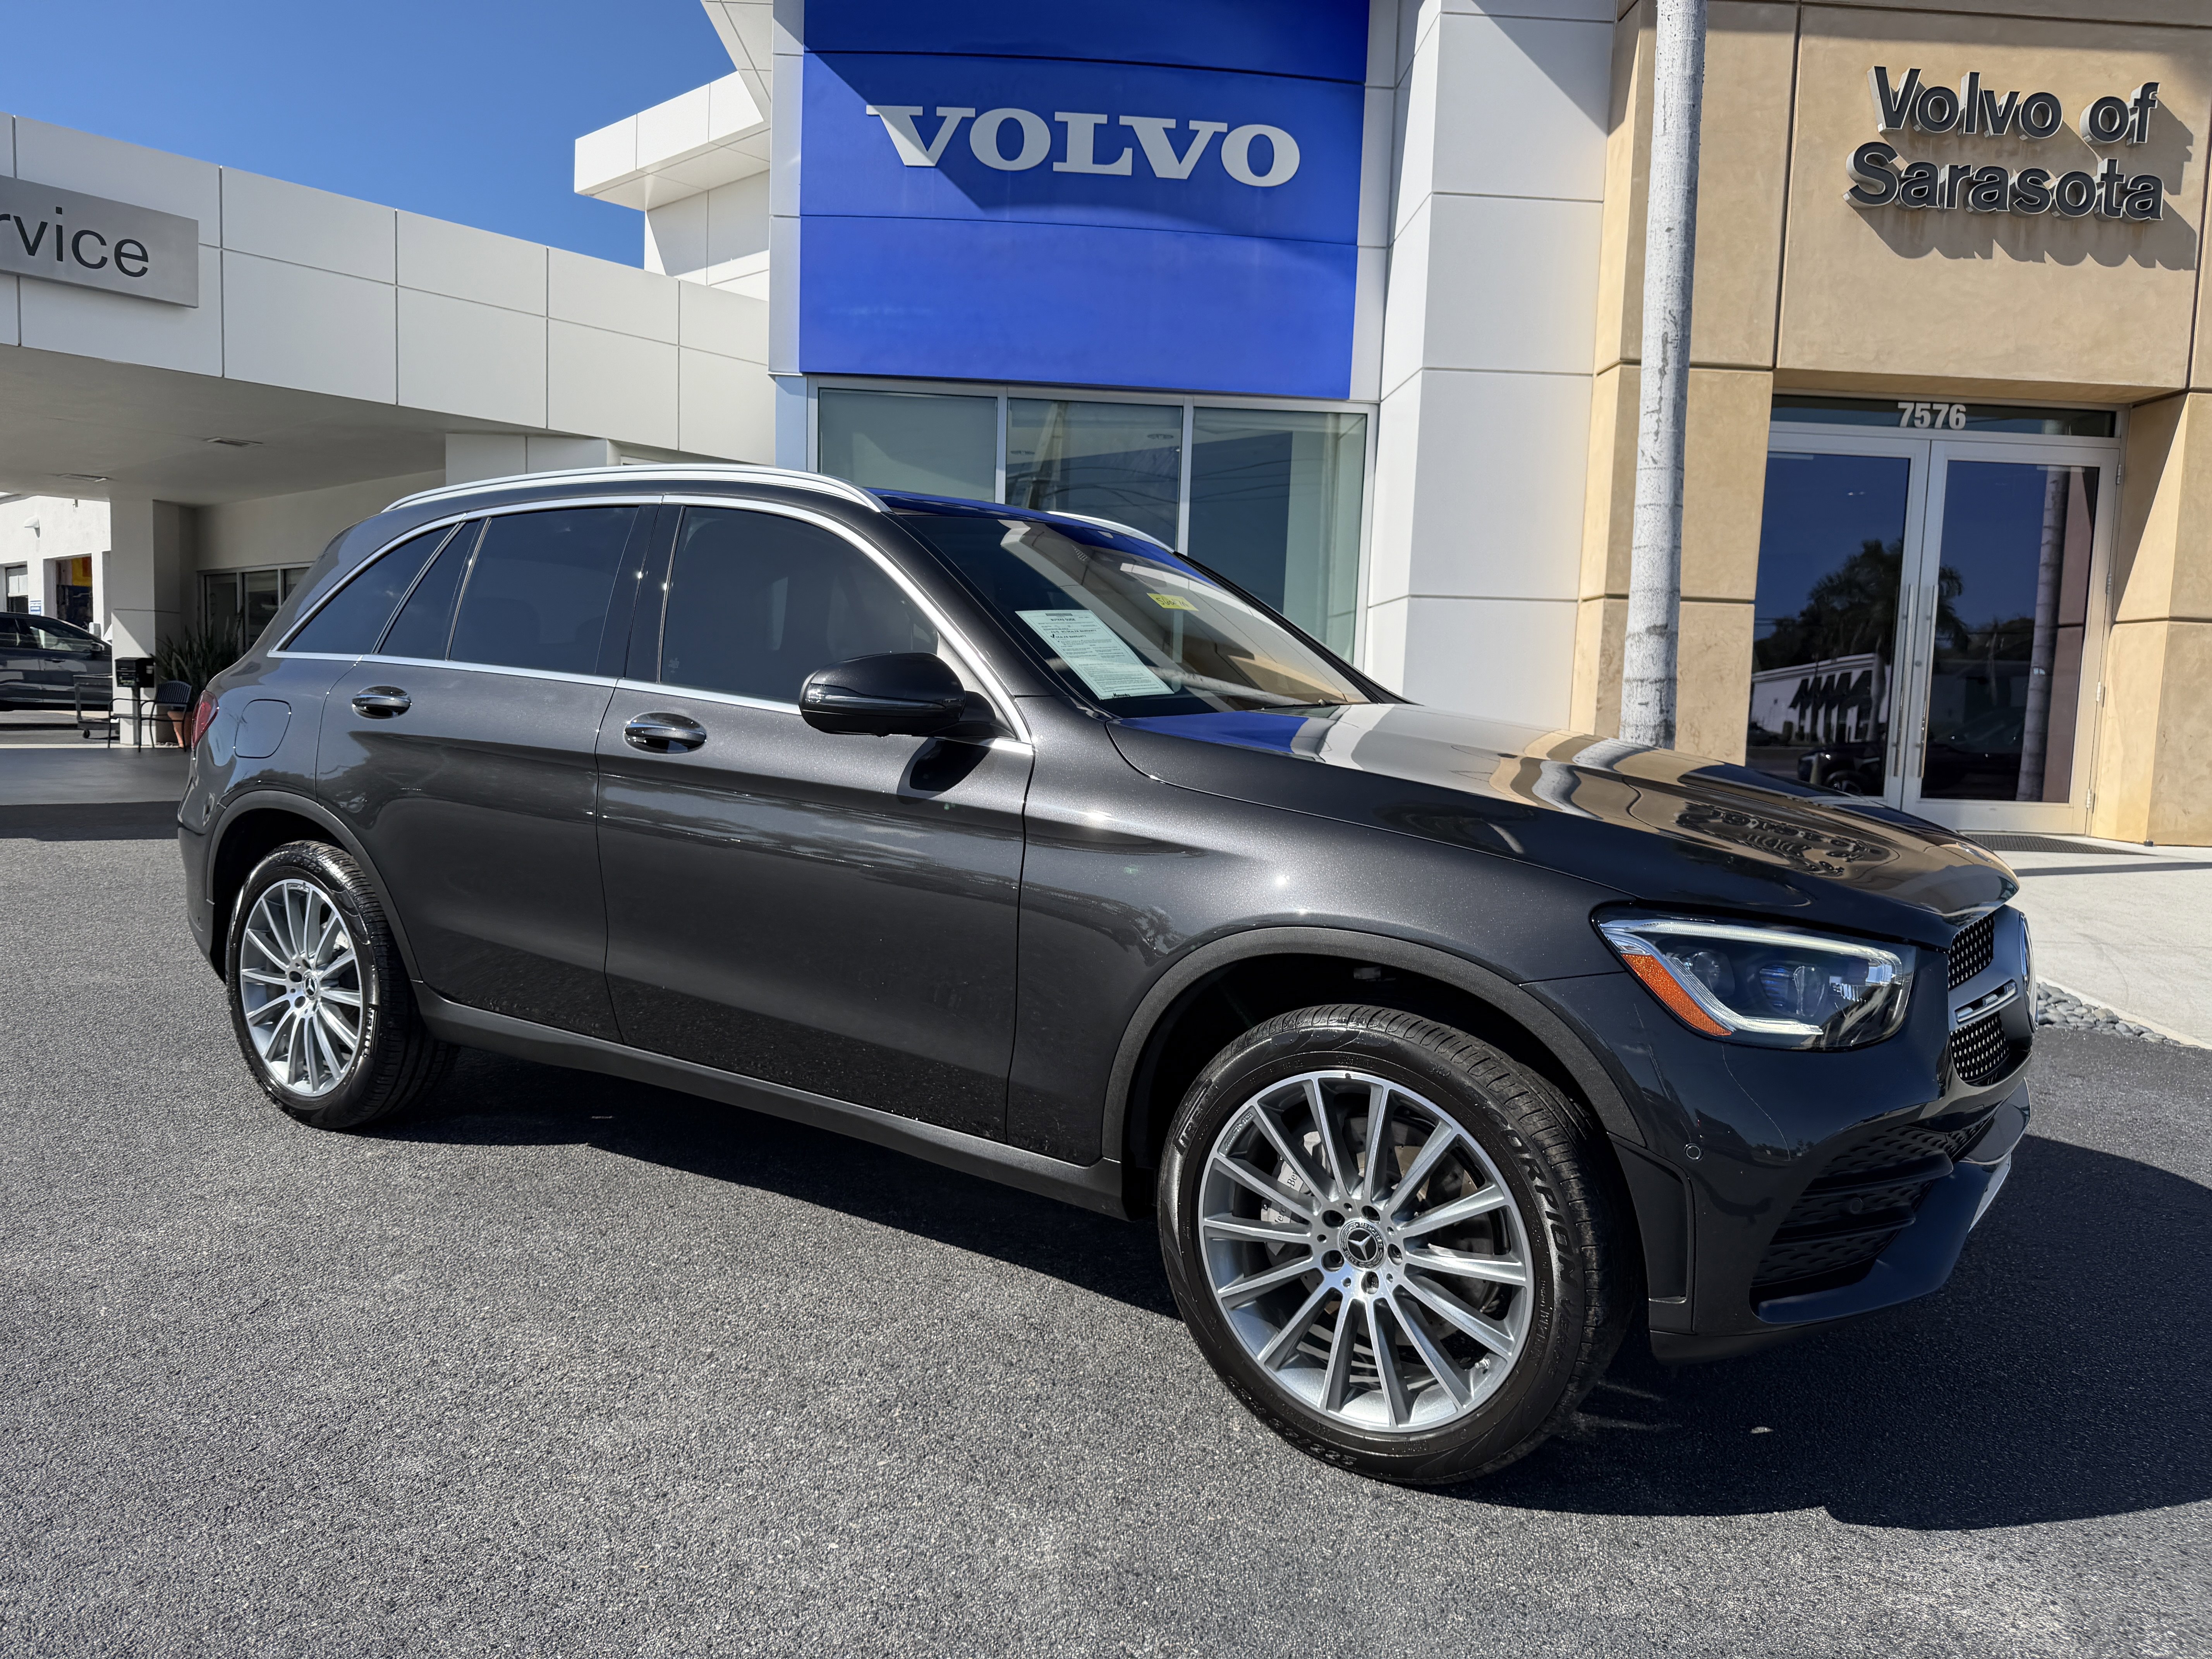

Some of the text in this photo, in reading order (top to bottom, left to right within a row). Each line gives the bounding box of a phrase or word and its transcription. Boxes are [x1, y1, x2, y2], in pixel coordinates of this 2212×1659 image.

[1867, 65, 2160, 144] Volvo of
[866, 105, 1300, 187] VOLVO
[1843, 141, 2164, 222] Sarasota
[1898, 402, 1966, 429] 7576
[1462, 1084, 1577, 1288] SCORPION
